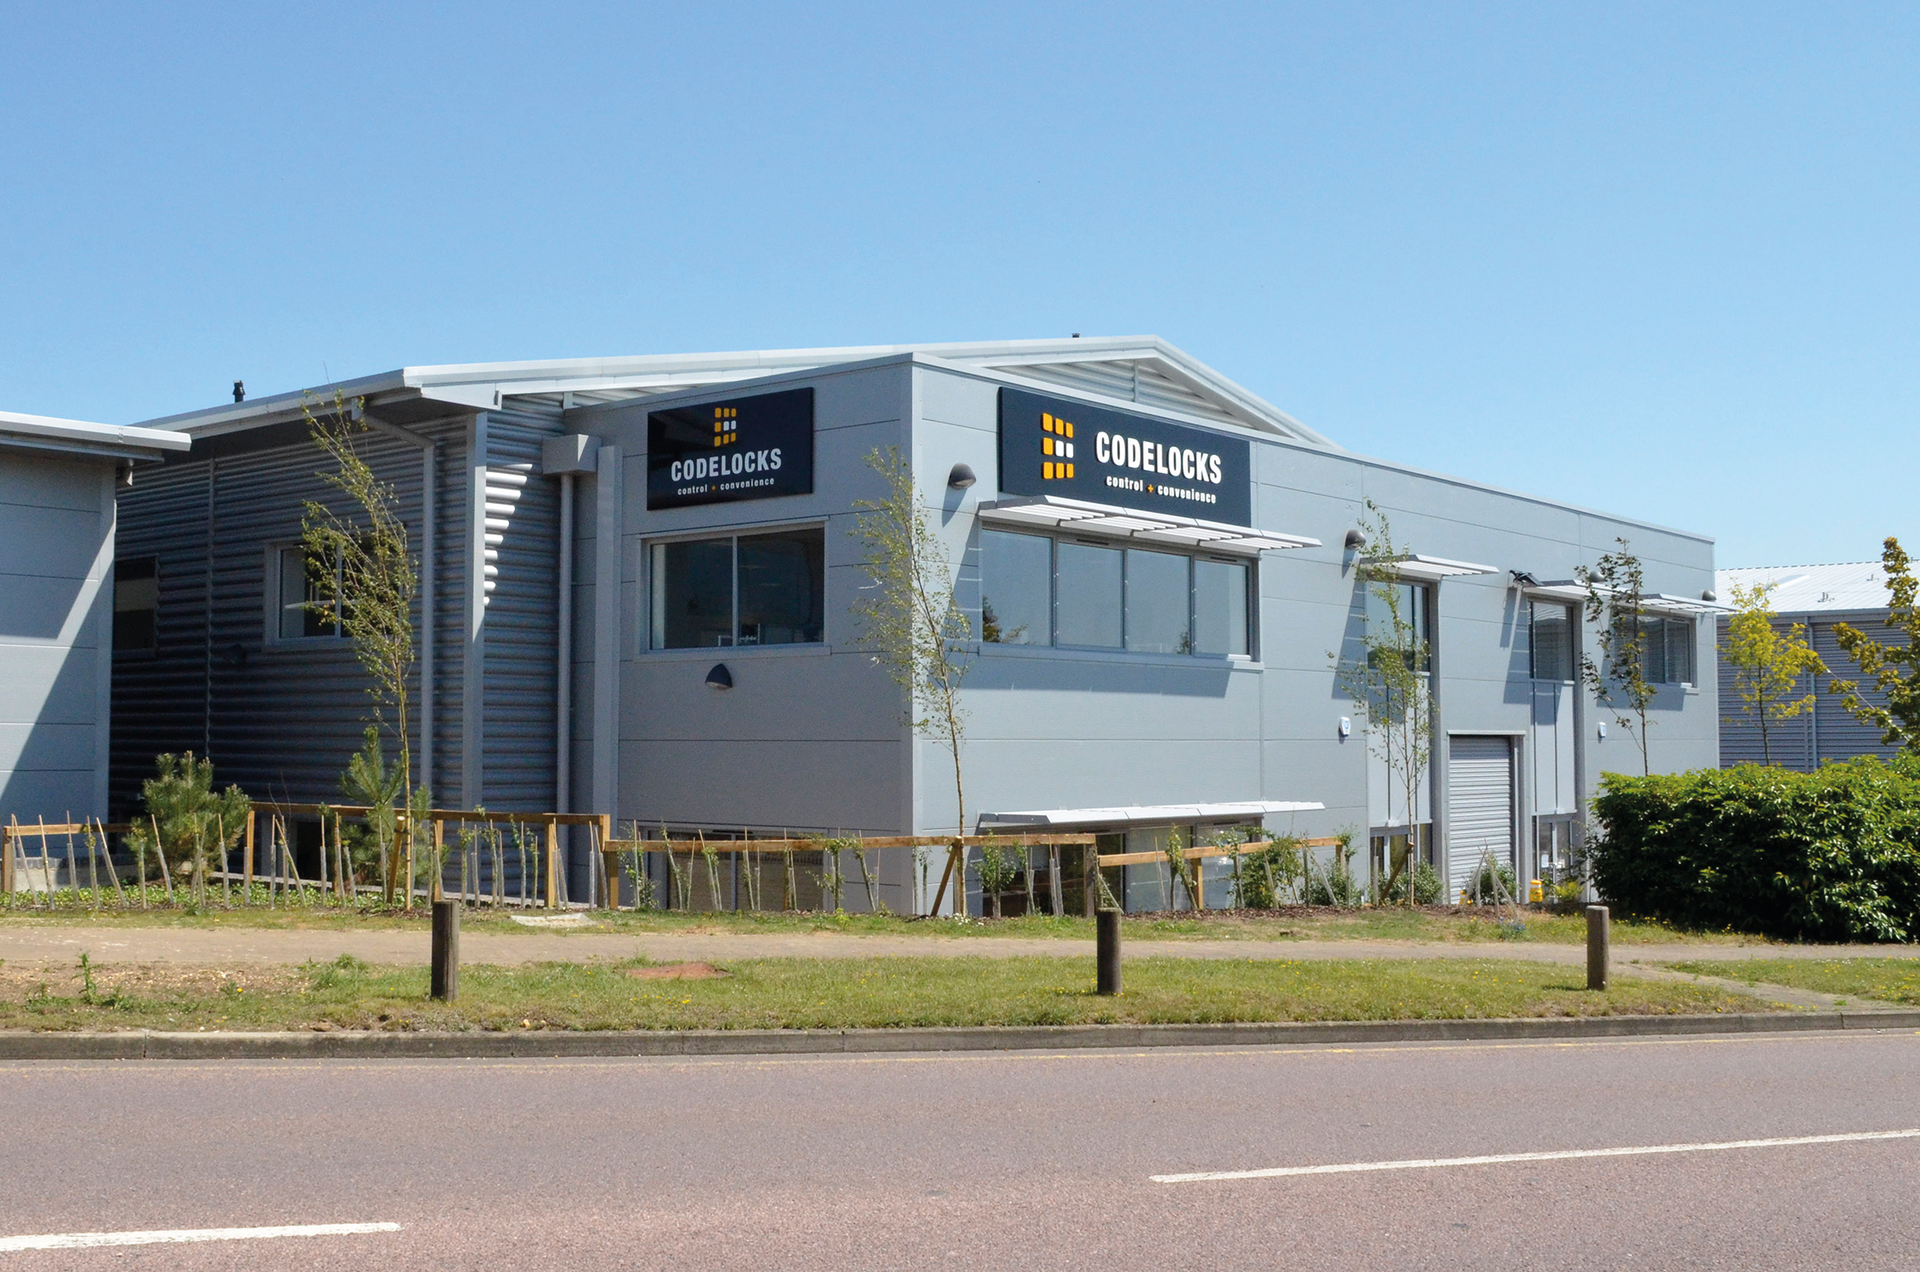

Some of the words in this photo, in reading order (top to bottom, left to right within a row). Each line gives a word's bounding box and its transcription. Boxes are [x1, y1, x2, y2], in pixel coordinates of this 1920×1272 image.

[671, 448, 782, 482] CODELOCKS
[1096, 431, 1222, 485] CODELOCKS
[677, 483, 709, 496] control
[720, 477, 775, 491] convenience
[1106, 475, 1144, 492] control
[1157, 484, 1217, 504] convenience
